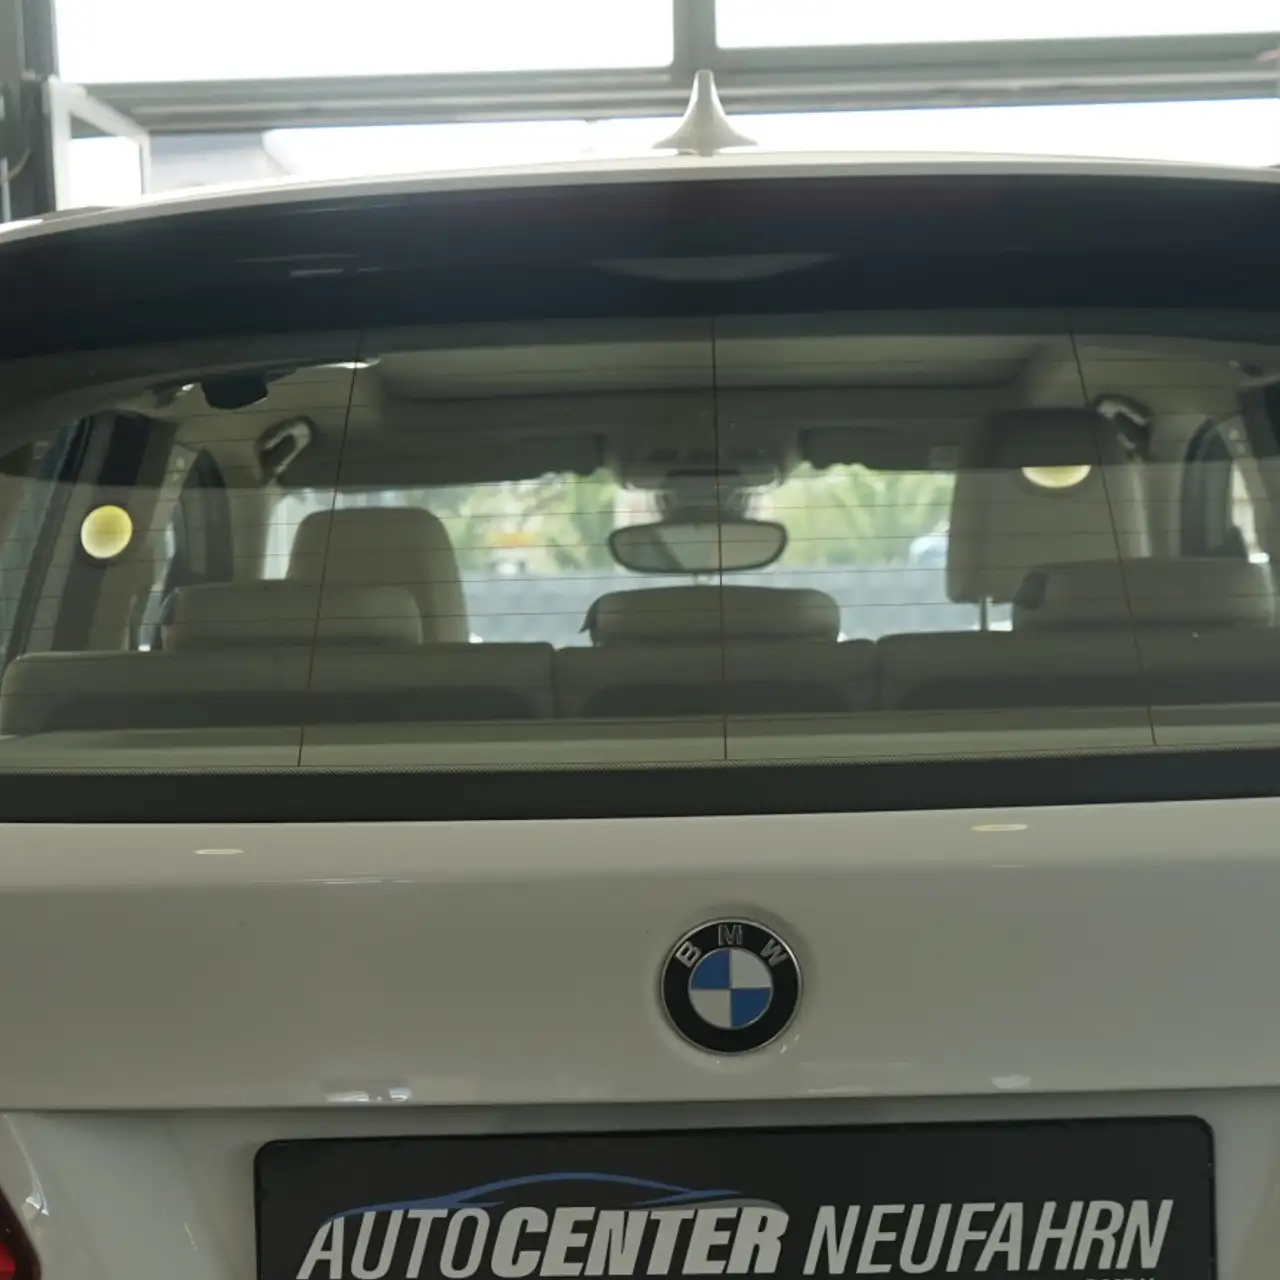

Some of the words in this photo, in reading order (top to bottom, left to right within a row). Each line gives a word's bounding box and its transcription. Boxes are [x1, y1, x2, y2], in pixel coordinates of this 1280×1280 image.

[676, 925, 788, 968] BMW
[296, 1203, 788, 1279] AUTOCENTER
[804, 1199, 1174, 1274] NEUFAHRN
